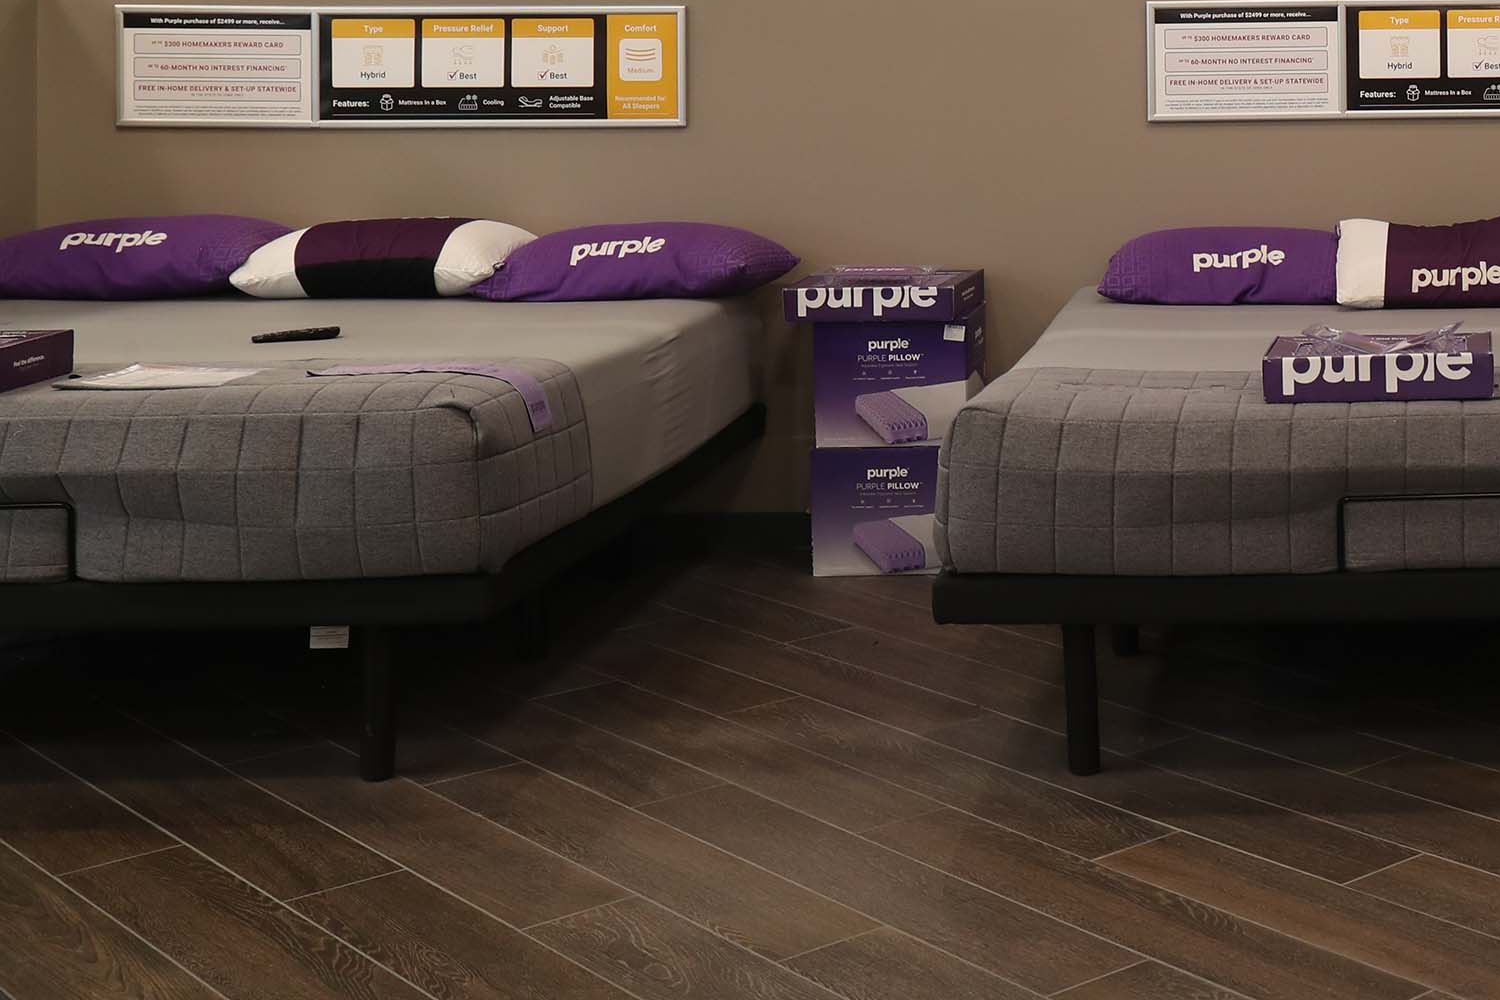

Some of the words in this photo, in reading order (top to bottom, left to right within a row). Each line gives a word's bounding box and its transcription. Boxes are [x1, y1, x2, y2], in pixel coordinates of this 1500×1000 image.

[364, 25, 384, 33] Type
[470, 24, 494, 32] Relief
[537, 25, 568, 33] Support
[1387, 62, 1412, 71] Hybrid
[360, 72, 386, 80] Hybrid
[60, 231, 167, 252] purple
[570, 237, 665, 265] purple
[1193, 245, 1285, 272] purple
[797, 286, 938, 317] purple
[868, 338, 909, 352] purple
[857, 354, 887, 362] PURPLE
[1282, 352, 1473, 396] purple
[867, 466, 908, 480] purple
[856, 482, 885, 490] PURPLE
